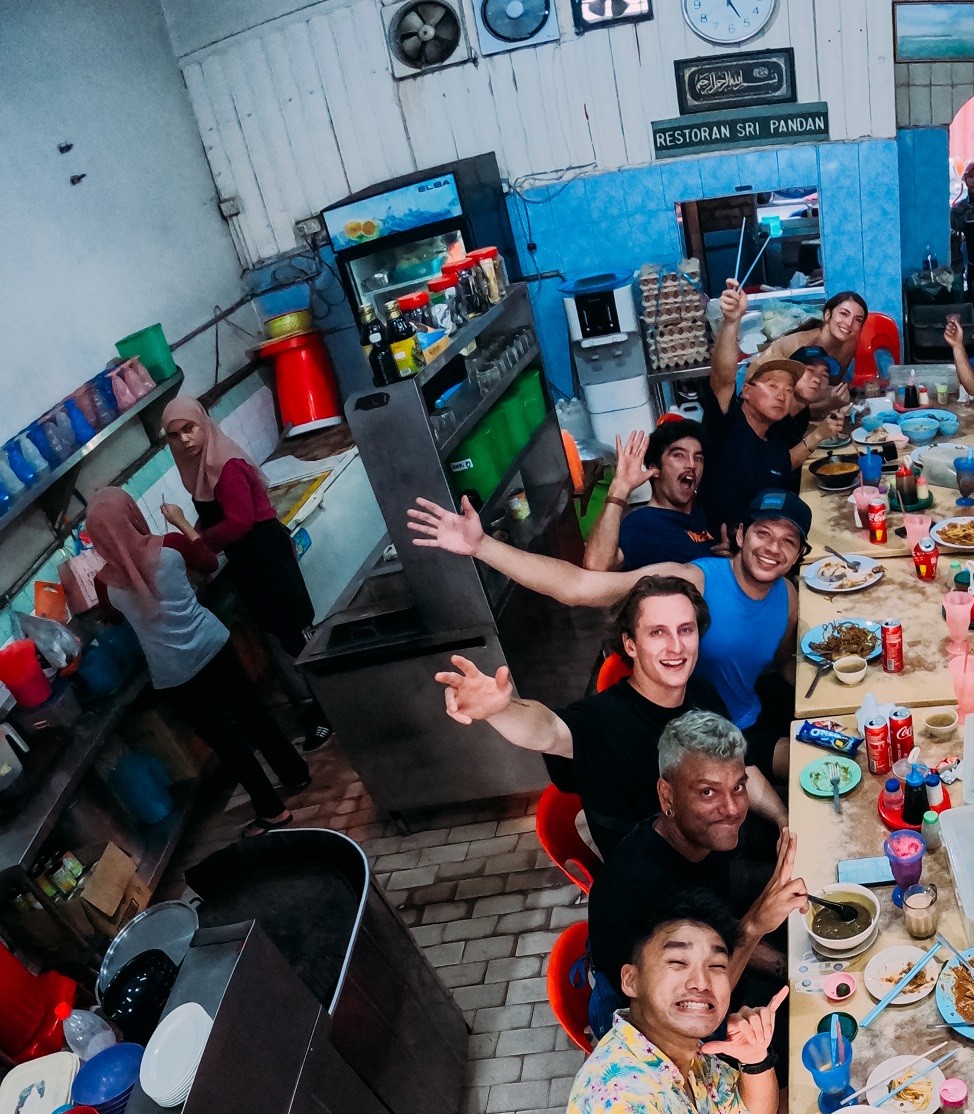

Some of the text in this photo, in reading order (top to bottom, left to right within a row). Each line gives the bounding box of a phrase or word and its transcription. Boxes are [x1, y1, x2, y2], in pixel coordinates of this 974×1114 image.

[752, 6, 759, 15] 4
[700, 13, 708, 23] 8
[743, 18, 751, 28] 5
[728, 23, 736, 34] 6
[656, 115, 825, 148] RESTORAN SRI PANDAN
[417, 178, 451, 193] ELBA
